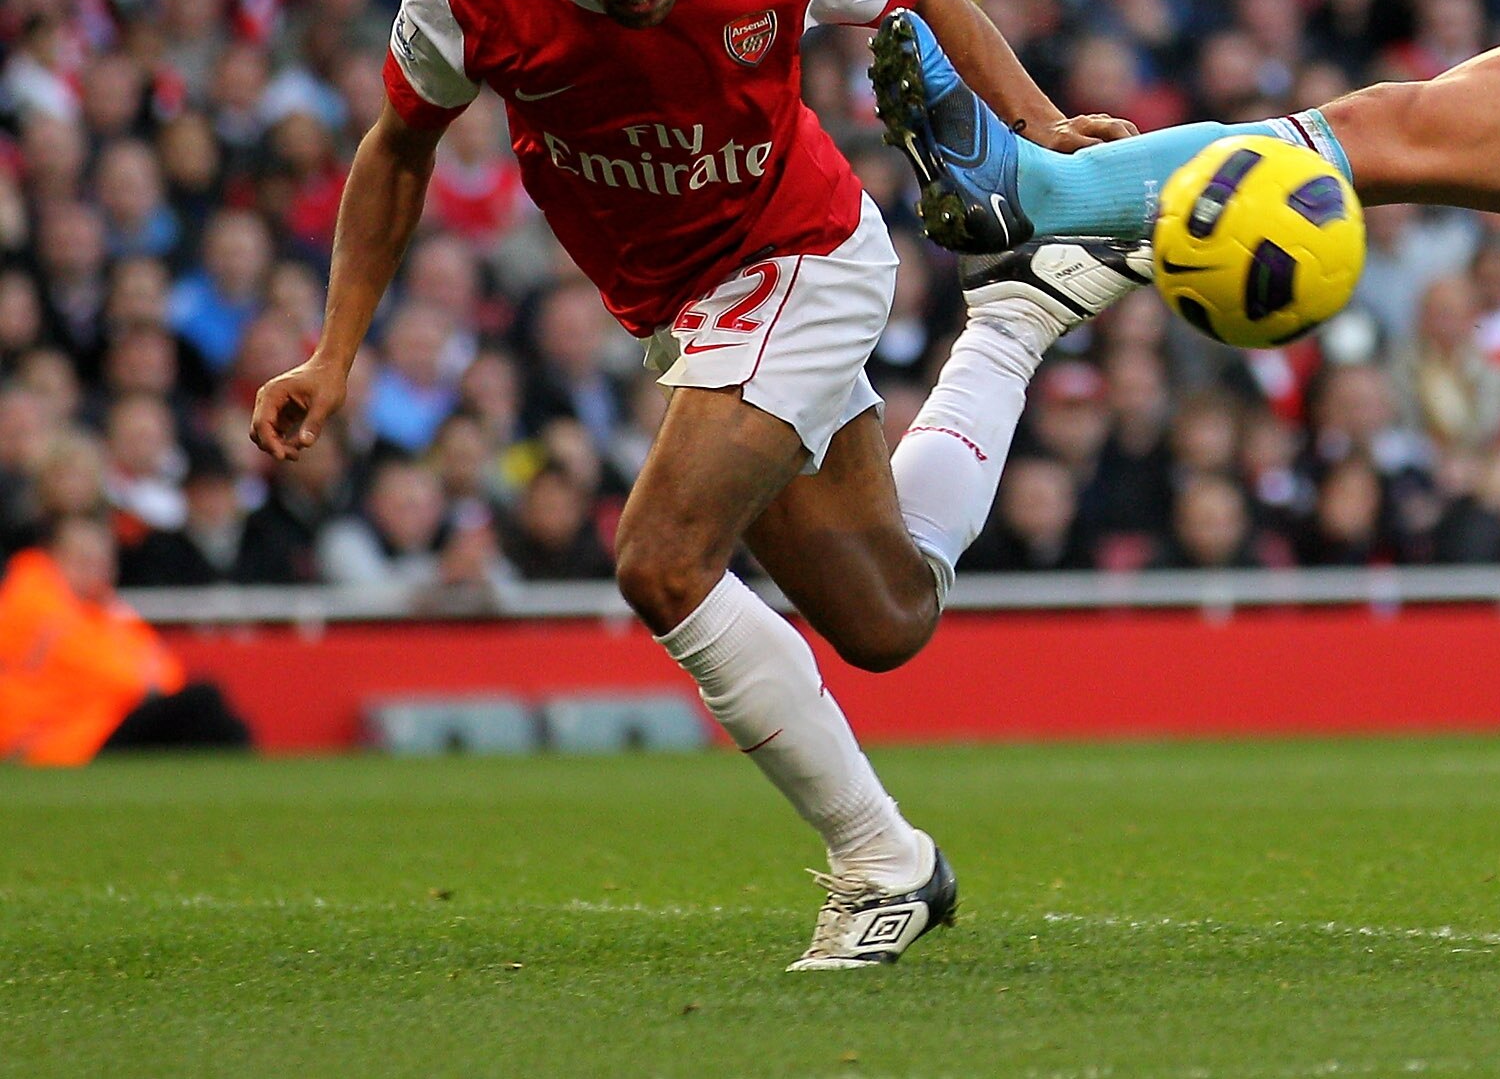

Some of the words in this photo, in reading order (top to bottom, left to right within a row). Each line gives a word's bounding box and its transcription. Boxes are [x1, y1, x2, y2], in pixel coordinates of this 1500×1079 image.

[732, 17, 769, 38] Arsenal
[622, 123, 704, 156] Fly
[543, 131, 773, 196] Emirate
